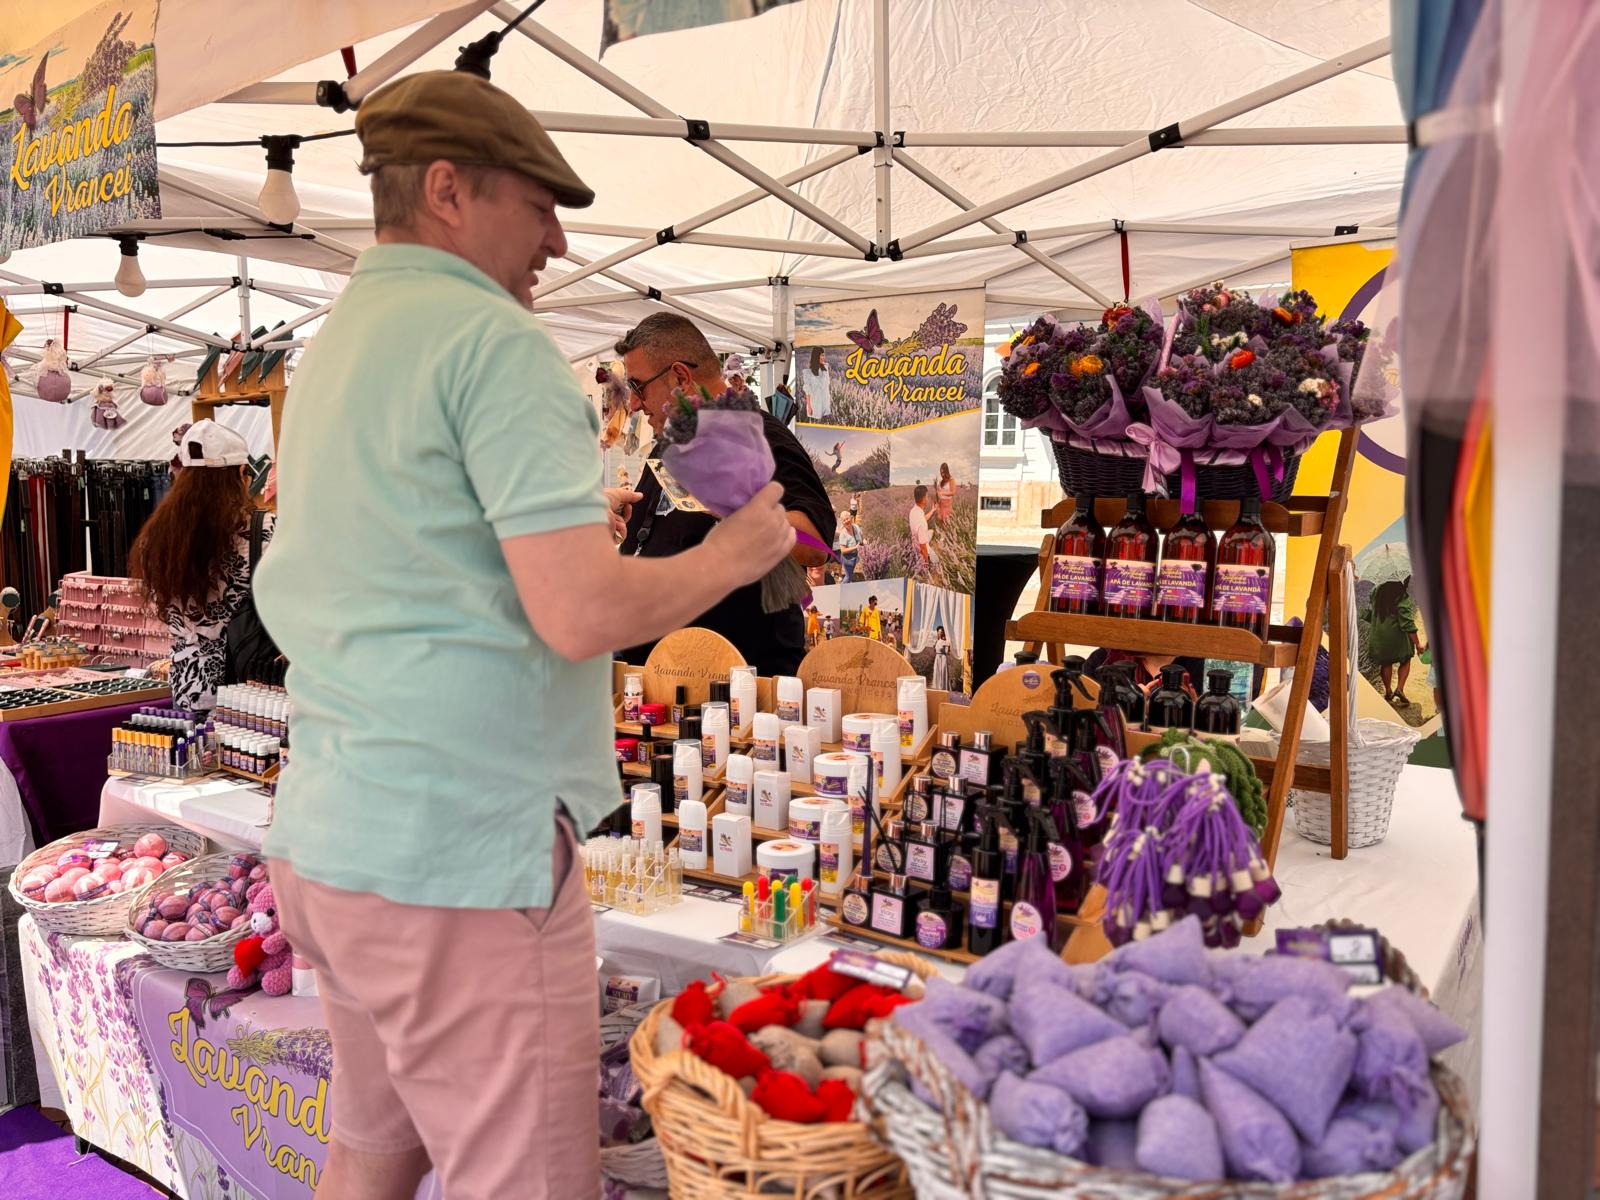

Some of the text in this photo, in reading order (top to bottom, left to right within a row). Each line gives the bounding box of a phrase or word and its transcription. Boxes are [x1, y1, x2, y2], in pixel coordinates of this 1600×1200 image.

[10, 84, 134, 190] Lavanda
[44, 152, 134, 217] Vrancei
[845, 344, 969, 385] Lavanda
[883, 377, 967, 404] Vrancei
[1122, 579, 1130, 587] DE
[654, 663, 730, 681] Lavanda Vranc
[811, 672, 897, 689] Lavanda Vrance
[990, 701, 1020, 717] Lava
[168, 1007, 333, 1144] Lavand
[231, 1104, 323, 1191] Vran
